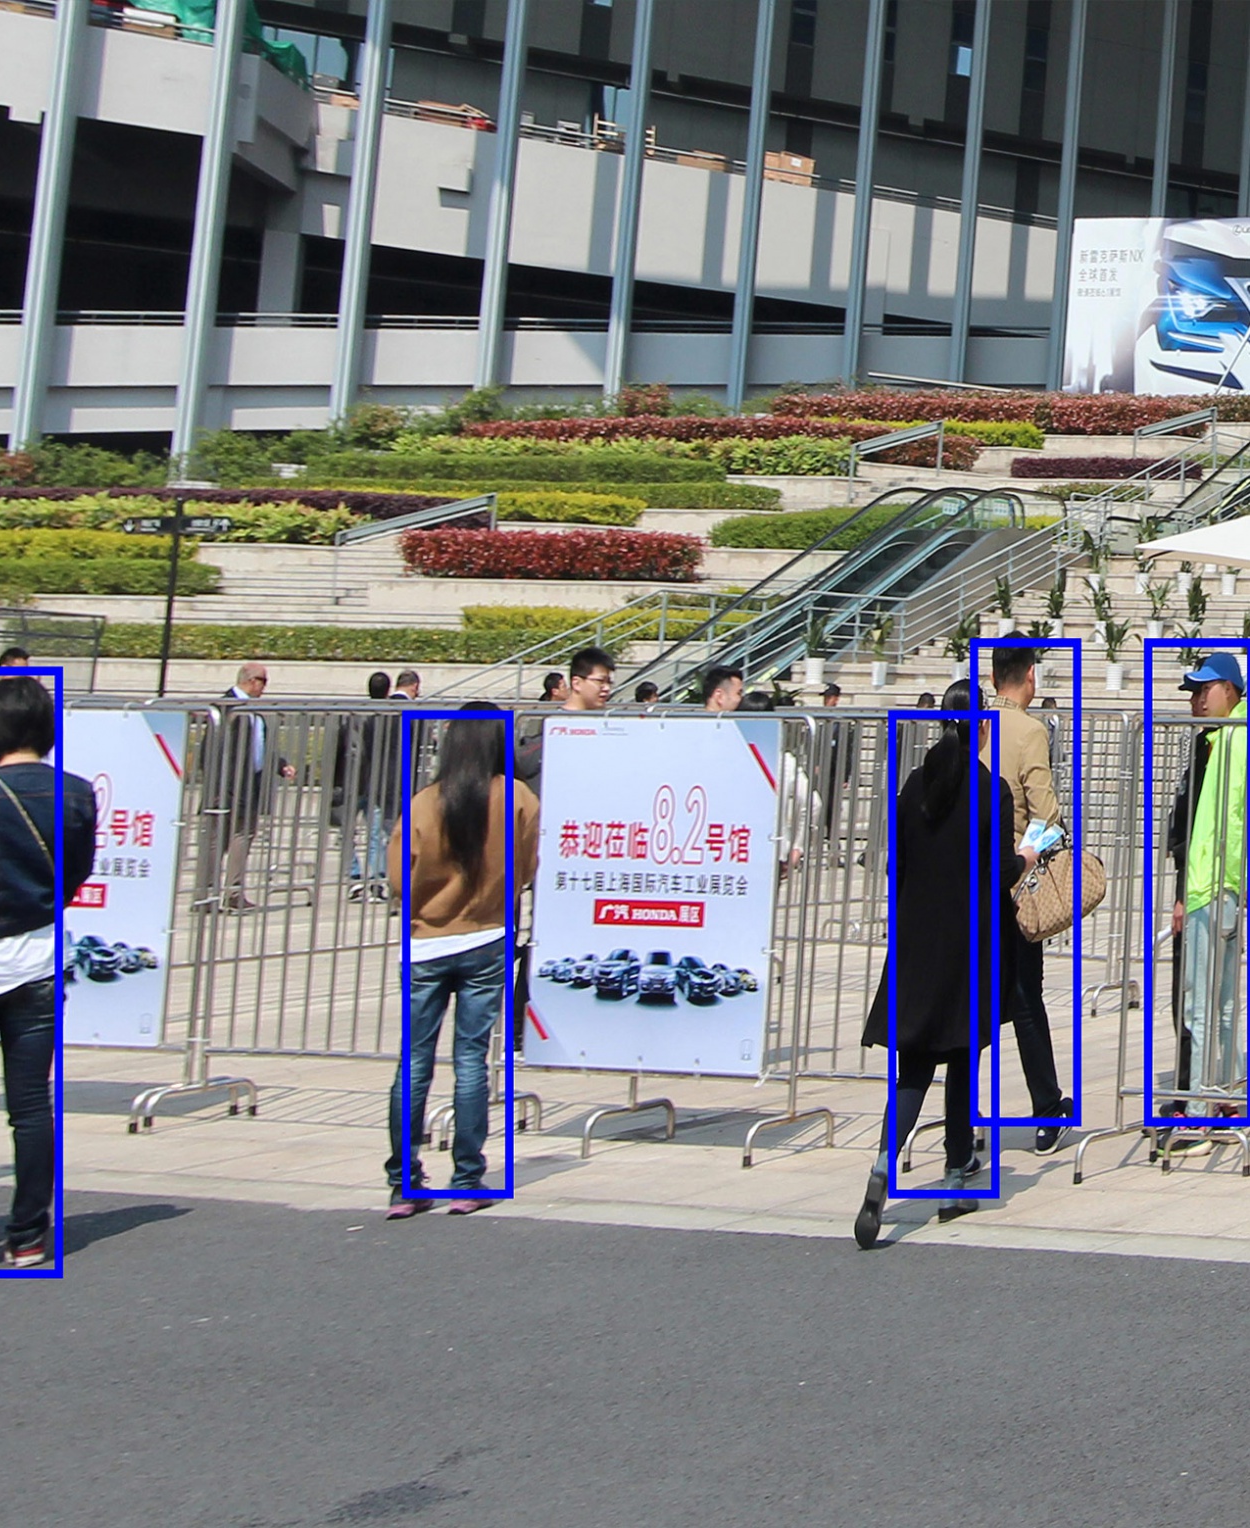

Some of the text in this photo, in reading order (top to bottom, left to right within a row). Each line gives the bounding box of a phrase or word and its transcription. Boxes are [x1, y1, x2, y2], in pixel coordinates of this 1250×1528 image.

[554, 871, 749, 897] 第十七届上海国际汽车工业展览会
[631, 908, 678, 922] HONDA
[678, 905, 701, 923] 展区
